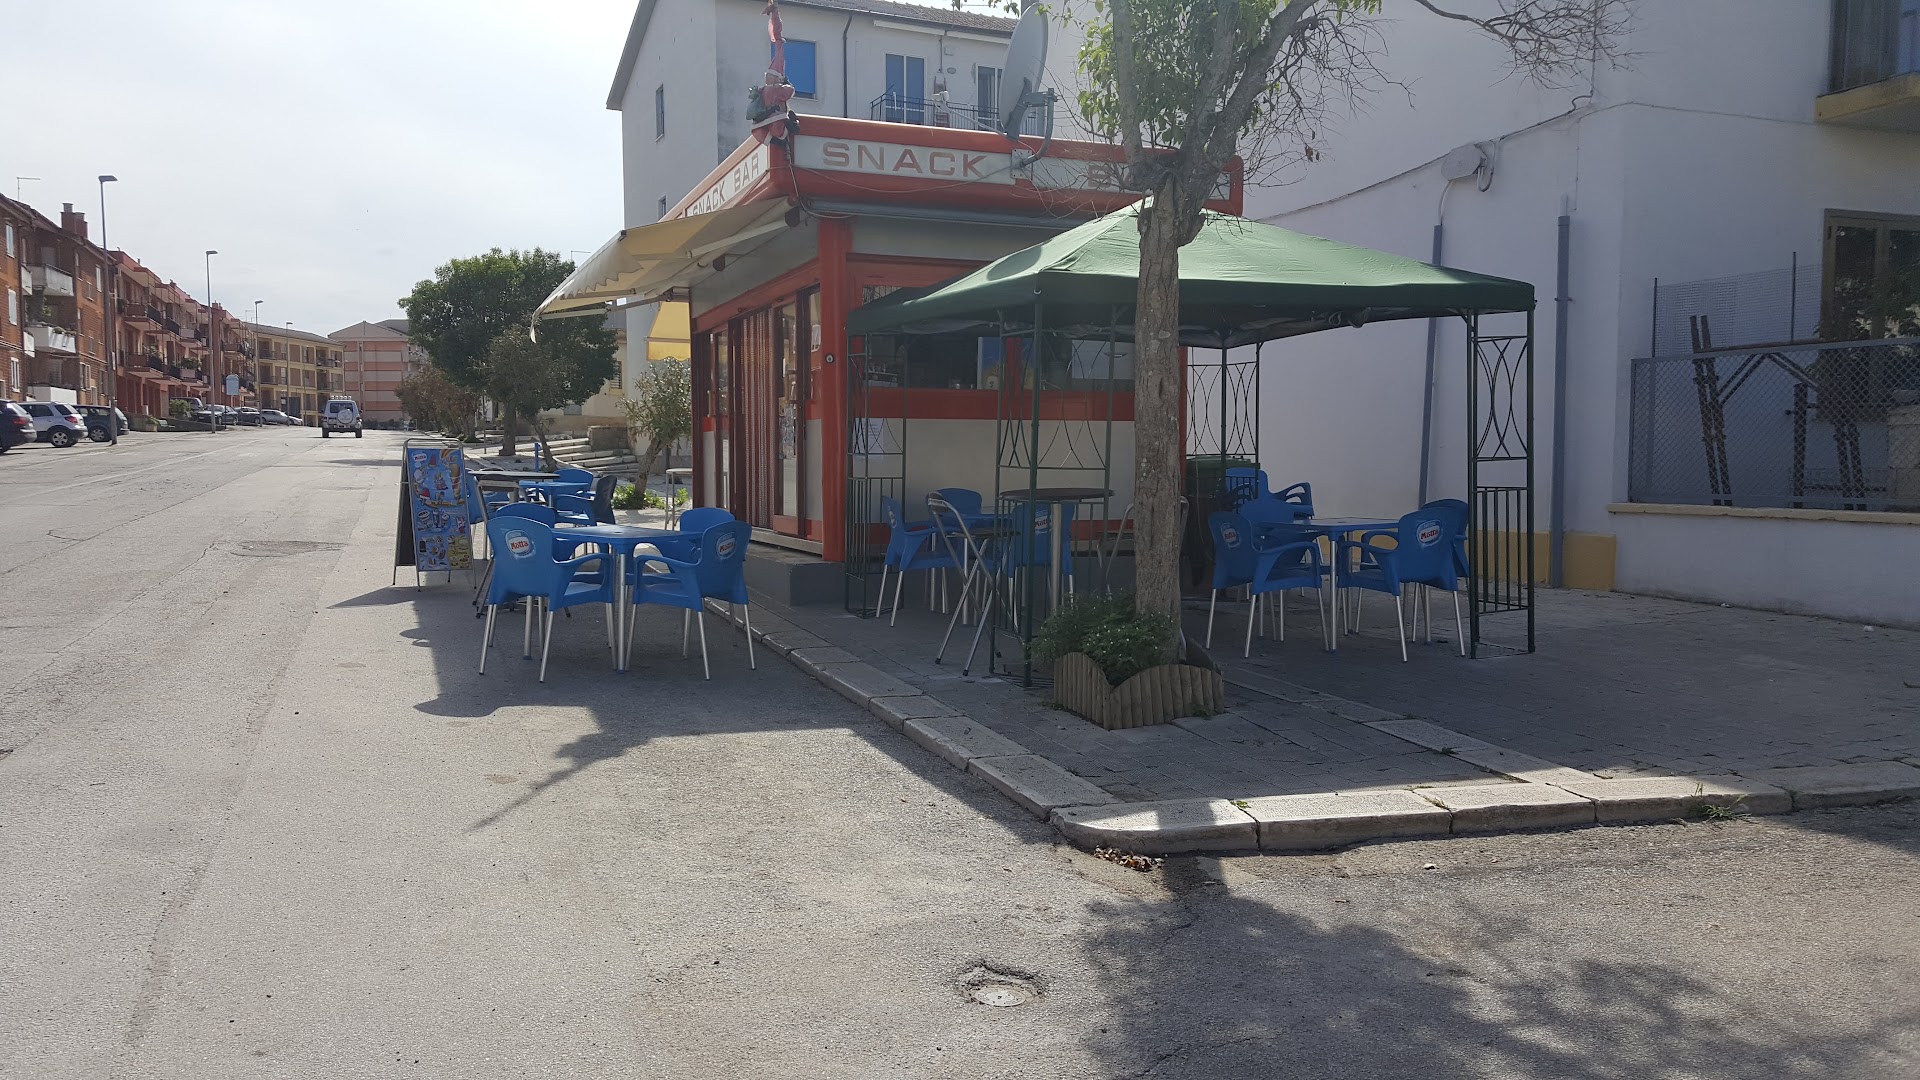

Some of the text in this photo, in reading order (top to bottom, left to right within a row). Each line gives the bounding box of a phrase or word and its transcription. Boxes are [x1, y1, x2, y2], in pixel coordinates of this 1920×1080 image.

[734, 152, 759, 193] BAR
[822, 142, 987, 179] SNACK
[510, 540, 529, 550] Motta
[1421, 529, 1439, 540] Motta
